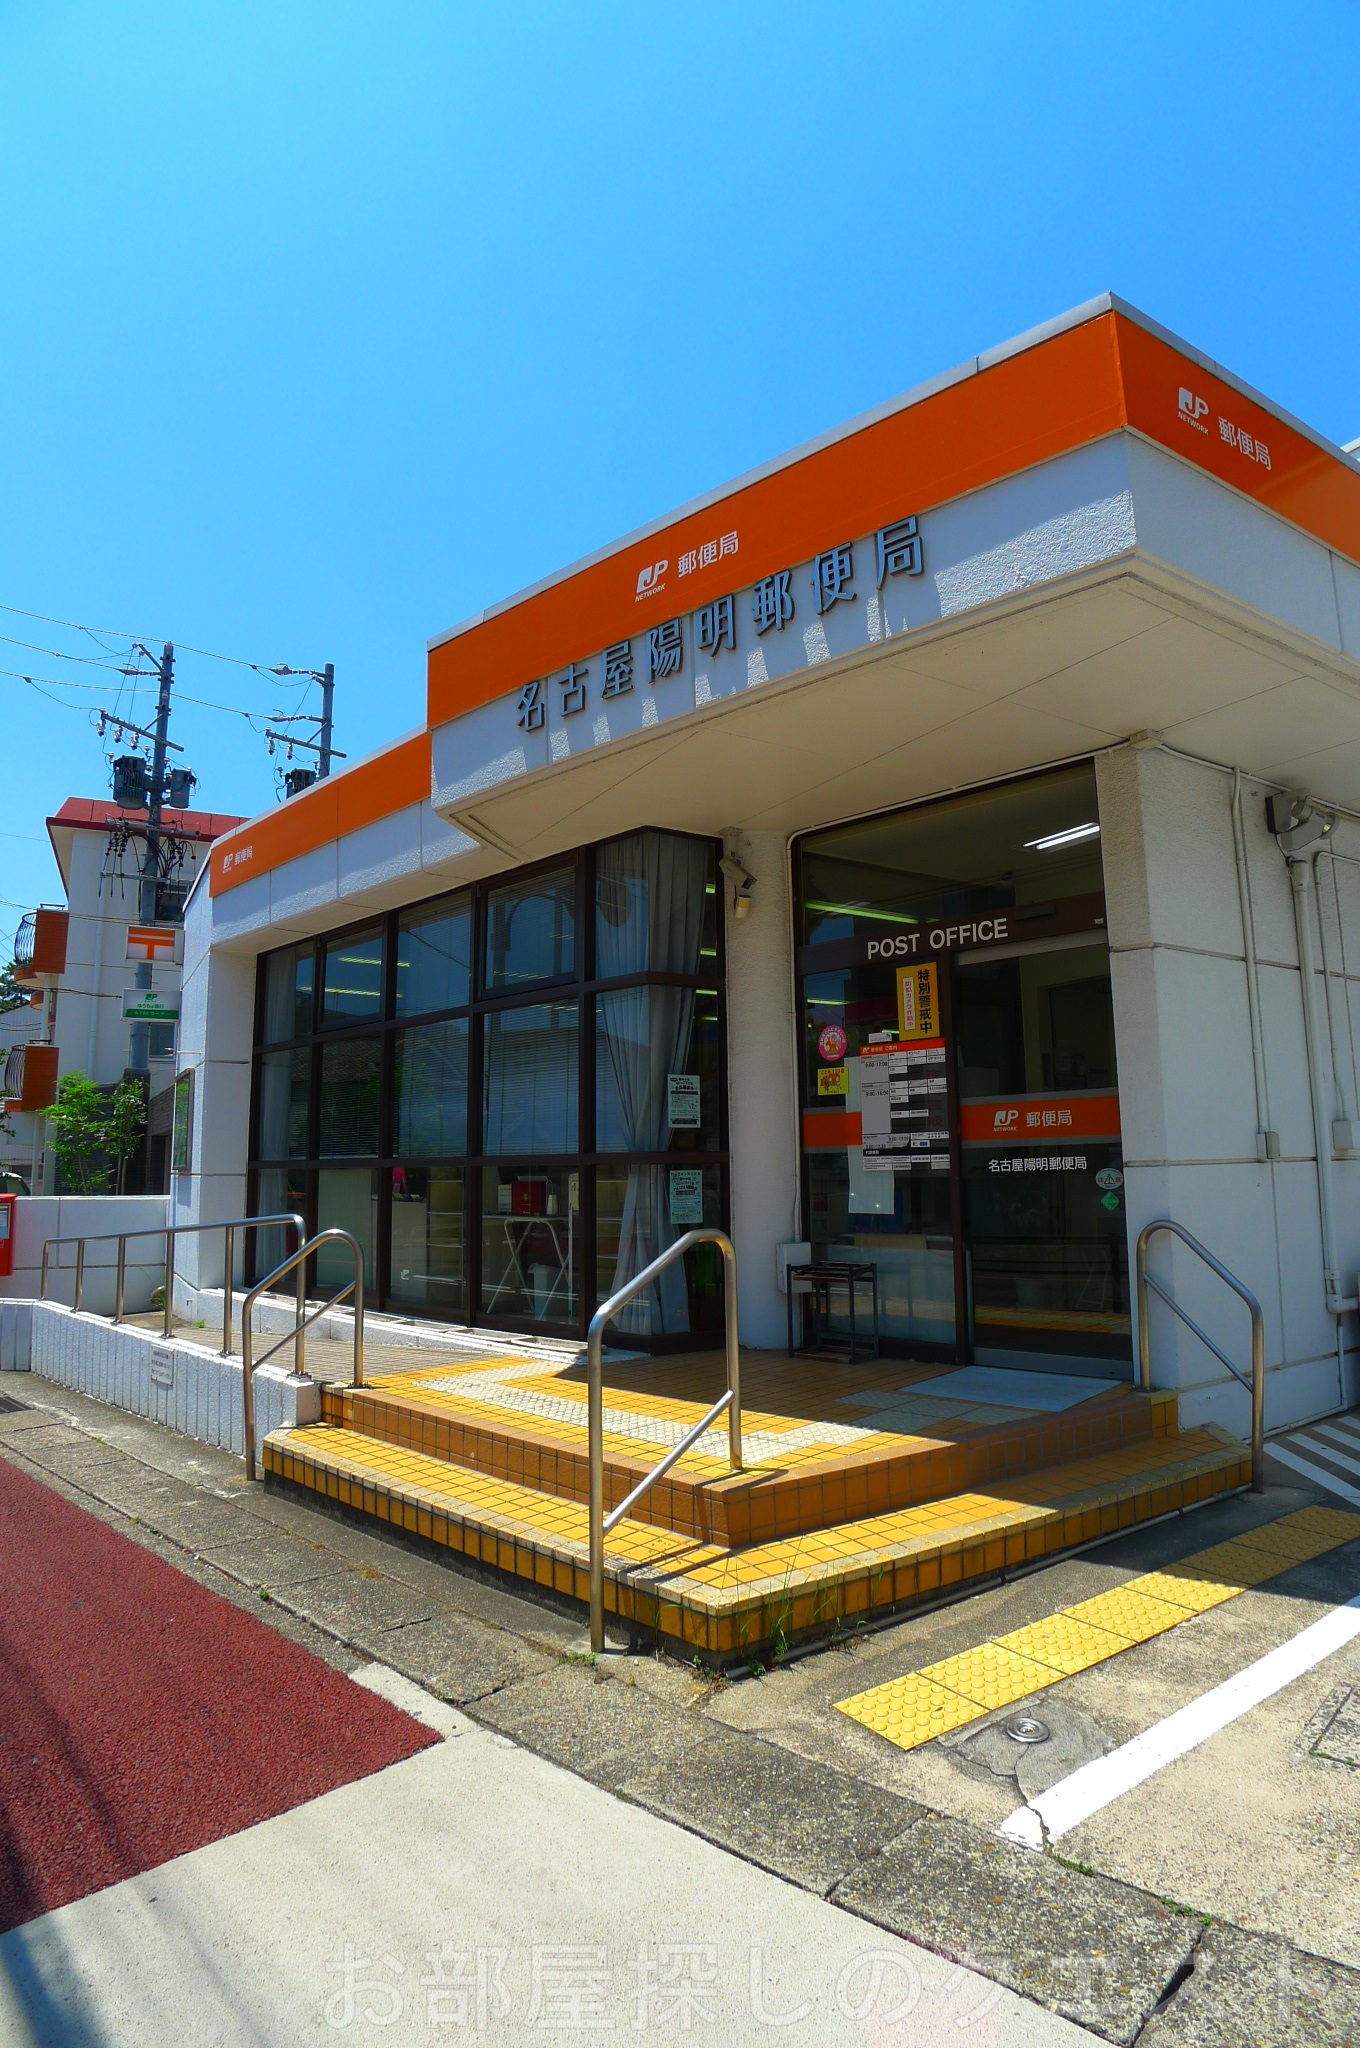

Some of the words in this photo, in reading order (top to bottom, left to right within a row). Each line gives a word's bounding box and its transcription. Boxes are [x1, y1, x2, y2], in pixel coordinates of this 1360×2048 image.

[1178, 386, 1209, 419] JP
[1177, 411, 1209, 436] NETWORK
[1218, 415, 1272, 471] 郵便局
[678, 530, 739, 578] 郵便局
[634, 583, 666, 603] NETWORK
[636, 559, 669, 594] JP
[516, 514, 925, 733] 名古屋陽明郵便局
[235, 845, 253, 866] 郵便局
[867, 933, 921, 960] POST
[929, 917, 1009, 949] OFFICE
[917, 969, 933, 1034] 特別警戒中
[993, 1109, 1019, 1126] JP
[1026, 1109, 1072, 1128] 郵便局
[988, 1156, 1087, 1172] 名古屋陽明郵便局
